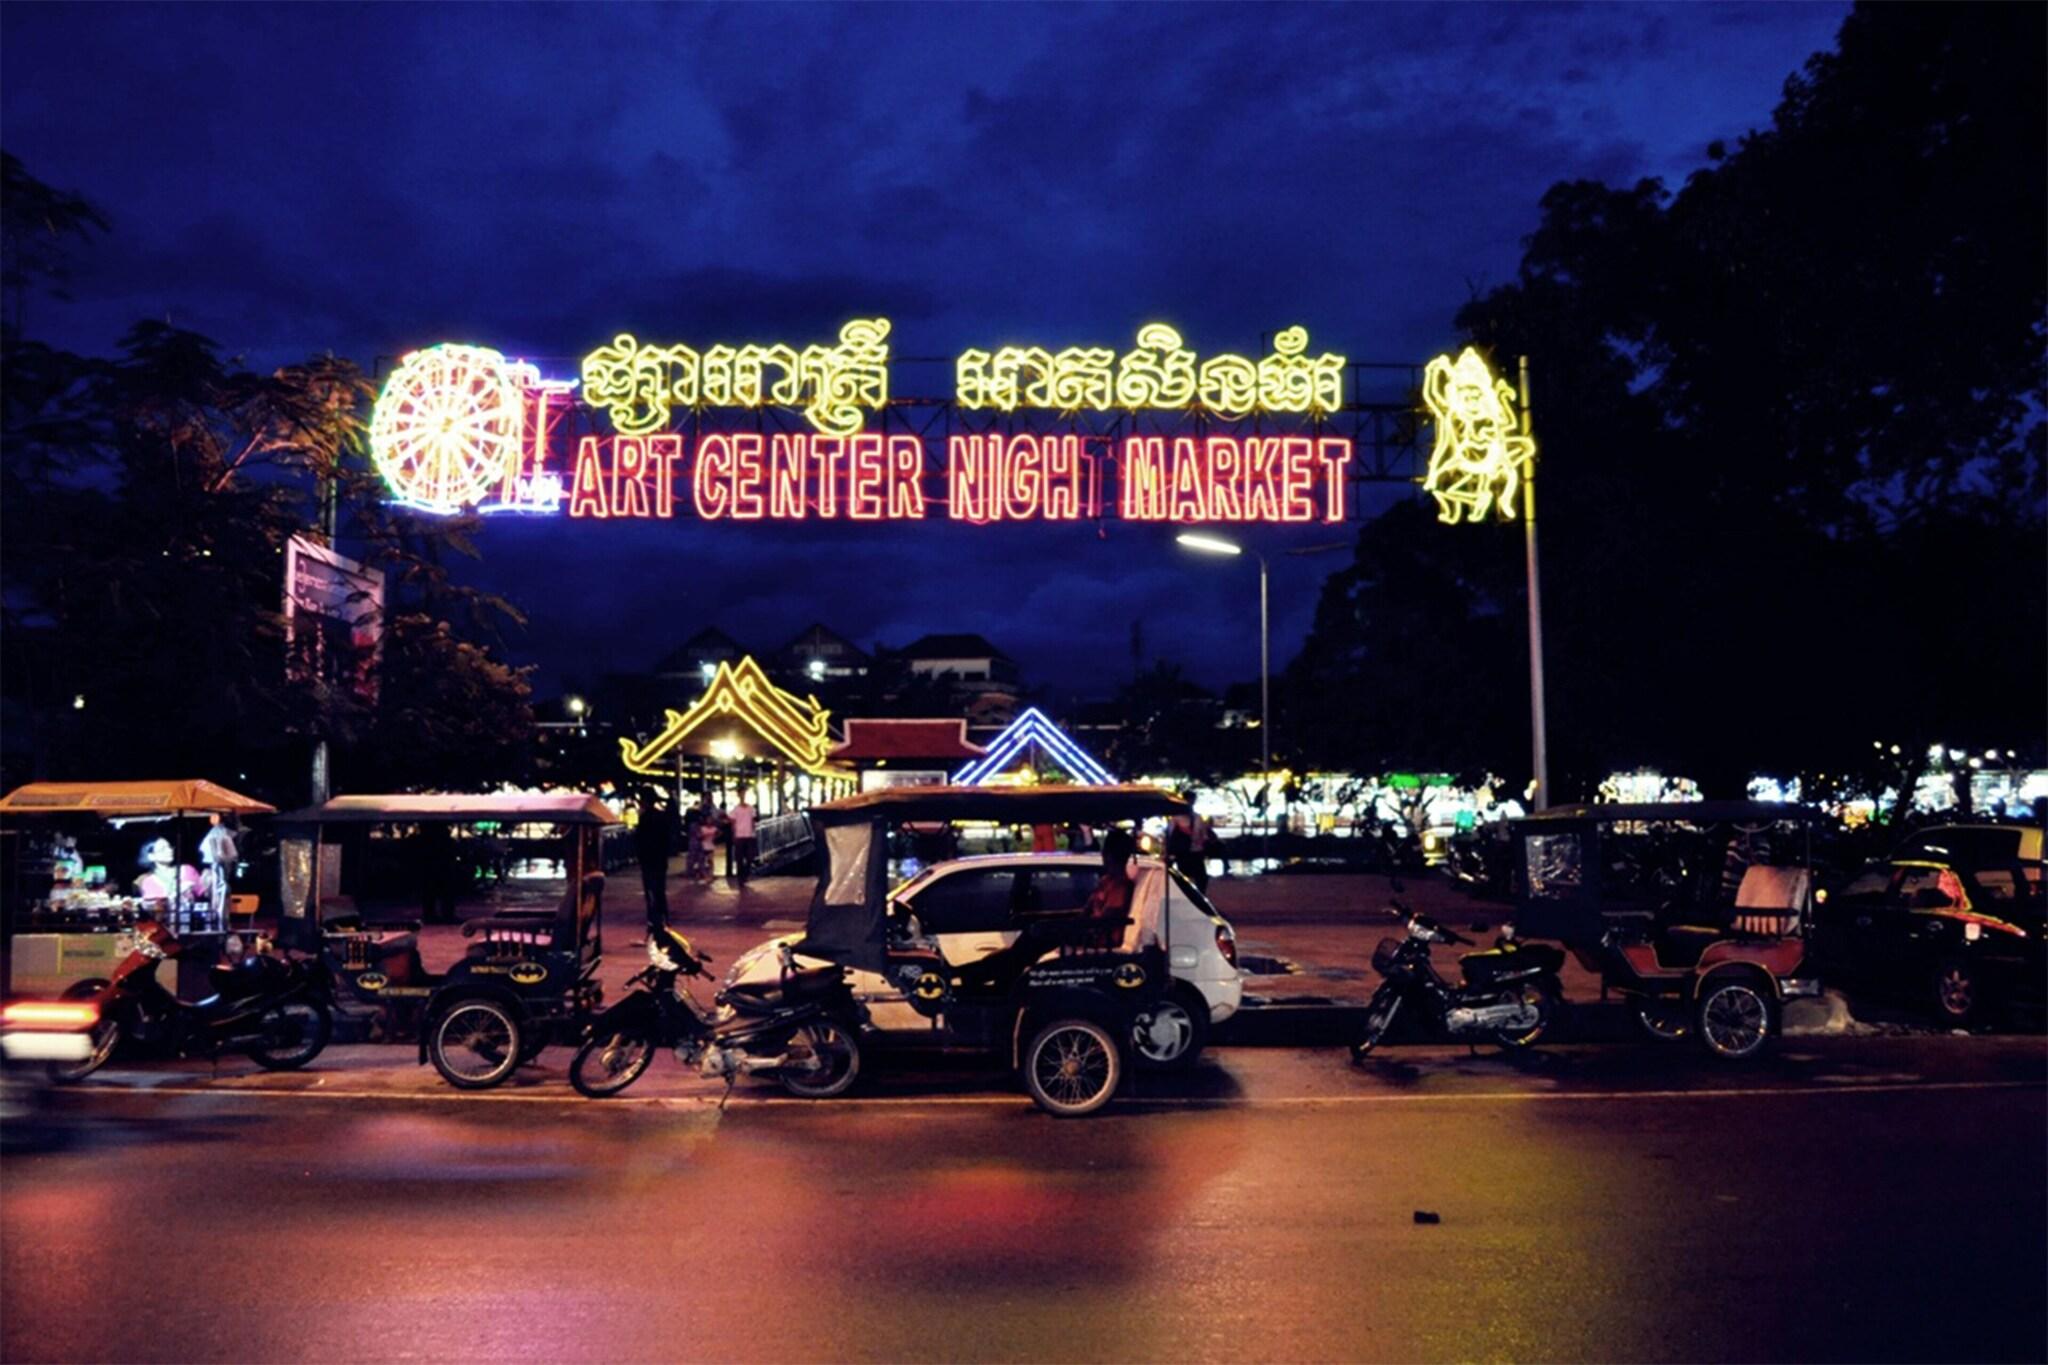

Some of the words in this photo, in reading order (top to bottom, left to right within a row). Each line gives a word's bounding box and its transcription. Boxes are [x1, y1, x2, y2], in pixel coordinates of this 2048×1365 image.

[569, 433, 683, 518] ART
[693, 433, 925, 519] CENTER
[949, 434, 1112, 519] NIGHT
[1123, 437, 1352, 521] MARKET
